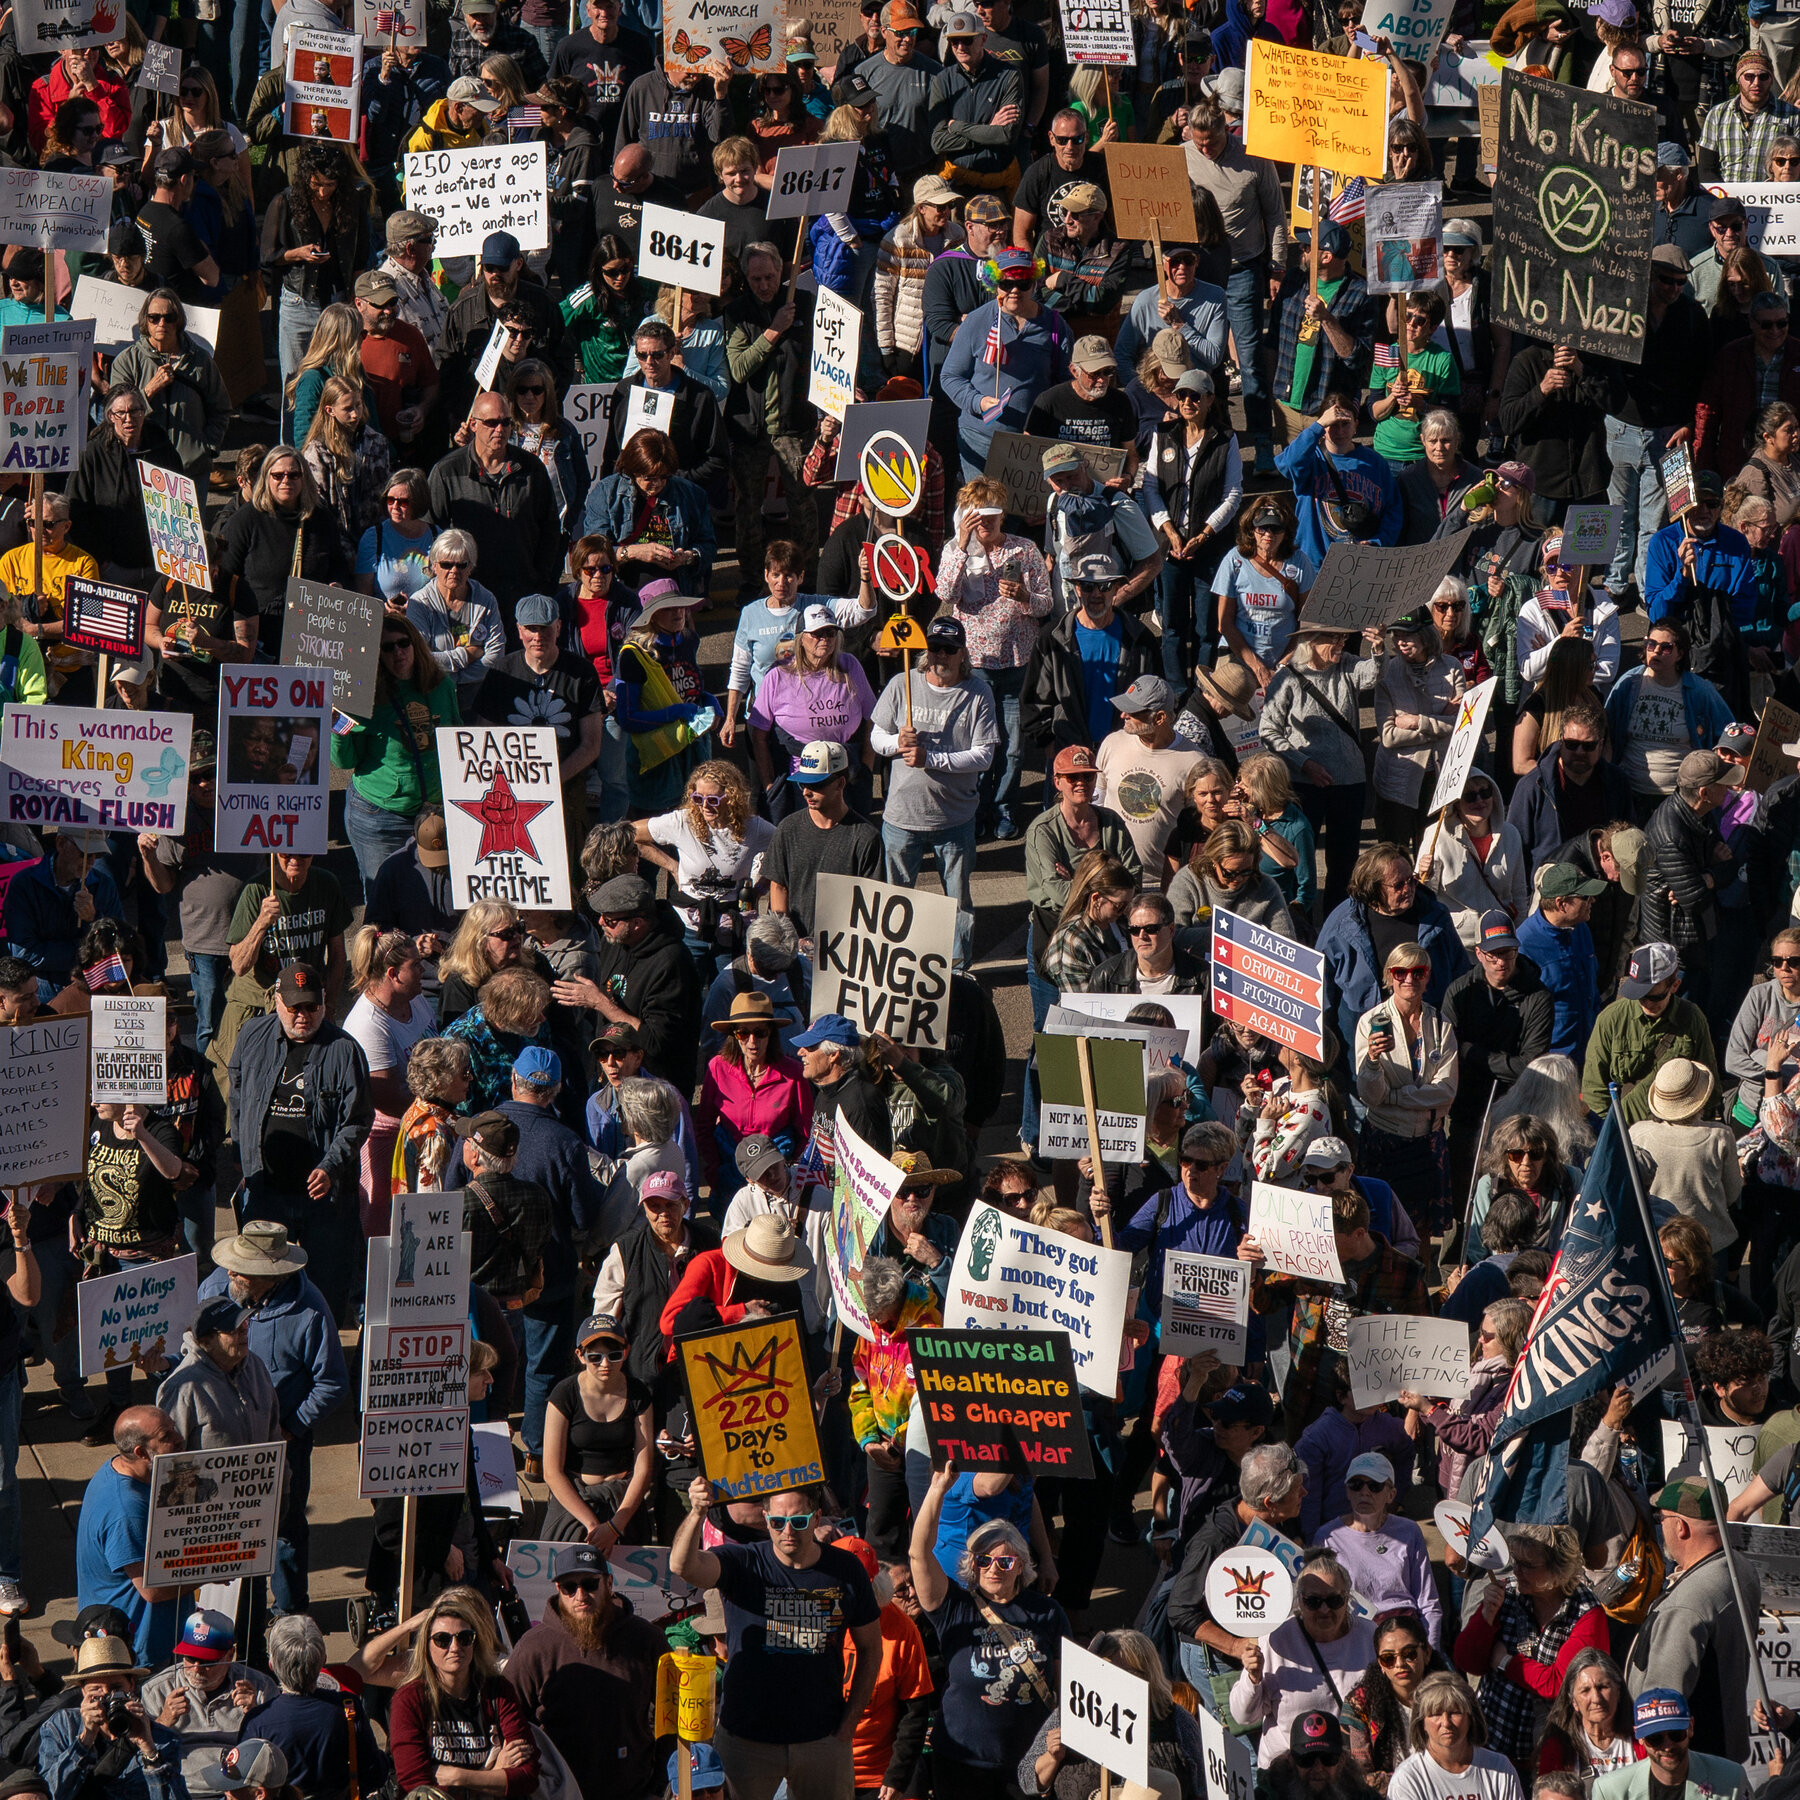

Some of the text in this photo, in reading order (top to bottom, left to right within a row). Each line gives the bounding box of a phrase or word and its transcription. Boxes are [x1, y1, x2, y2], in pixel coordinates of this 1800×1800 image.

[689, 2, 758, 19] MONARCH
[1070, 9, 1122, 30] OFF!
[307, 32, 328, 41] THERE
[1379, 15, 1443, 38] ABOVE
[299, 40, 317, 48] ONLY
[1393, 42, 1427, 62] THE
[1258, 44, 1309, 66] WHATEVER
[1321, 56, 1346, 69] BUILT
[597, 86, 619, 96] NO
[1510, 89, 1656, 190] No Kings
[409, 152, 538, 178] 250 years ago
[1120, 164, 1169, 179] DUMP
[7, 172, 39, 186] STOP
[47, 177, 64, 189] the
[780, 167, 846, 194] 8647
[16, 194, 94, 214] IMPEACH
[1122, 198, 1184, 217] TRUMP
[1738, 194, 1756, 205] NO
[1, 217, 105, 240] Trump Administration
[1494, 226, 1506, 240] No
[649, 231, 715, 267] 8647
[1503, 256, 1645, 339] No Nazis
[9, 330, 91, 345] Planet Trump
[825, 338, 845, 361] Try
[30, 357, 68, 385] THE
[813, 350, 851, 391] VIAGRA
[3, 392, 64, 416] PEOPLE
[3, 443, 69, 468] ABIDE
[144, 489, 199, 523] NOT HATE
[147, 505, 198, 542] MAKES
[151, 531, 206, 563] AMERICA
[157, 549, 207, 588] GREAT
[74, 581, 138, 605] PRO-AMERICA
[300, 586, 372, 621] The power of the
[1246, 593, 1277, 606] NASTY
[169, 601, 217, 619] RESIST
[307, 612, 346, 634] people is
[71, 633, 135, 654] ANTI-TRUMP
[298, 633, 344, 660] STRONGER
[224, 676, 324, 708] YES ON
[809, 699, 845, 713] FUCK
[11, 714, 173, 743] This wannabe
[809, 715, 849, 728] TRUMP
[457, 731, 542, 760] RAGE
[62, 740, 133, 783] King
[464, 760, 552, 784] AGAINST
[9, 772, 126, 797] Deserves a
[9, 794, 174, 828] ROYAL FLUSH
[219, 794, 321, 811] VOTING RIGHTS
[241, 815, 299, 848] ACT
[487, 856, 527, 875] THE
[468, 875, 552, 903] REGIME
[850, 886, 914, 943] NO
[1249, 929, 1296, 962] MAKE
[819, 929, 947, 1000] KINGS
[1242, 955, 1303, 994] ORWELL
[104, 1001, 155, 1011] HISTORY
[1242, 981, 1303, 1020] FICTION
[114, 1018, 144, 1029] EYES
[1248, 1012, 1296, 1043] AGAIN
[10, 1025, 81, 1050] KING
[114, 1036, 144, 1047] YOU
[96, 1064, 162, 1080] GOVERNED
[117, 1082, 138, 1091] BEING
[138, 1081, 162, 1091] LOOTED
[428, 1211, 449, 1225] WE
[425, 1236, 453, 1250] ARE
[424, 1261, 450, 1276] ALL
[1068, 1253, 1098, 1275] got
[1174, 1263, 1238, 1282] RESISTING
[114, 1276, 175, 1301] No Kings
[1000, 1265, 1095, 1307] money for
[1181, 1277, 1229, 1295] KINGS
[391, 1295, 456, 1308] IMMIGRANTS
[102, 1302, 158, 1326] No Wars
[100, 1321, 169, 1348] No Empires
[1171, 1321, 1236, 1341] SINCE 1776
[1362, 1320, 1419, 1341] THE
[1528, 1268, 1649, 1391] KINGS
[399, 1336, 452, 1358] STOP
[1352, 1346, 1465, 1370] WRONG ICE
[921, 1369, 1069, 1397] Healthcare
[1389, 1367, 1468, 1386] MELTING
[369, 1392, 444, 1408] KIDNAPPING
[718, 1391, 789, 1429] 220
[368, 1417, 465, 1436] DEMOCRACY
[966, 1403, 1071, 1432] Cheaper
[724, 1423, 788, 1452] Days
[205, 1451, 277, 1469] COME ON
[399, 1442, 432, 1457] NOT
[749, 1449, 775, 1468] to
[938, 1439, 1072, 1464] Than War
[221, 1467, 274, 1484] PEOPLE
[369, 1462, 459, 1481] OLIGARCHY
[233, 1482, 273, 1498] NOW
[187, 1511, 239, 1524] BROTHER
[164, 1520, 260, 1538] EVERYBODY GET
[182, 1531, 241, 1546] TOGETHER
[163, 1551, 255, 1569] MOTHERFUCKER
[1236, 1596, 1265, 1610] NO
[1069, 1680, 1137, 1745] 8647
